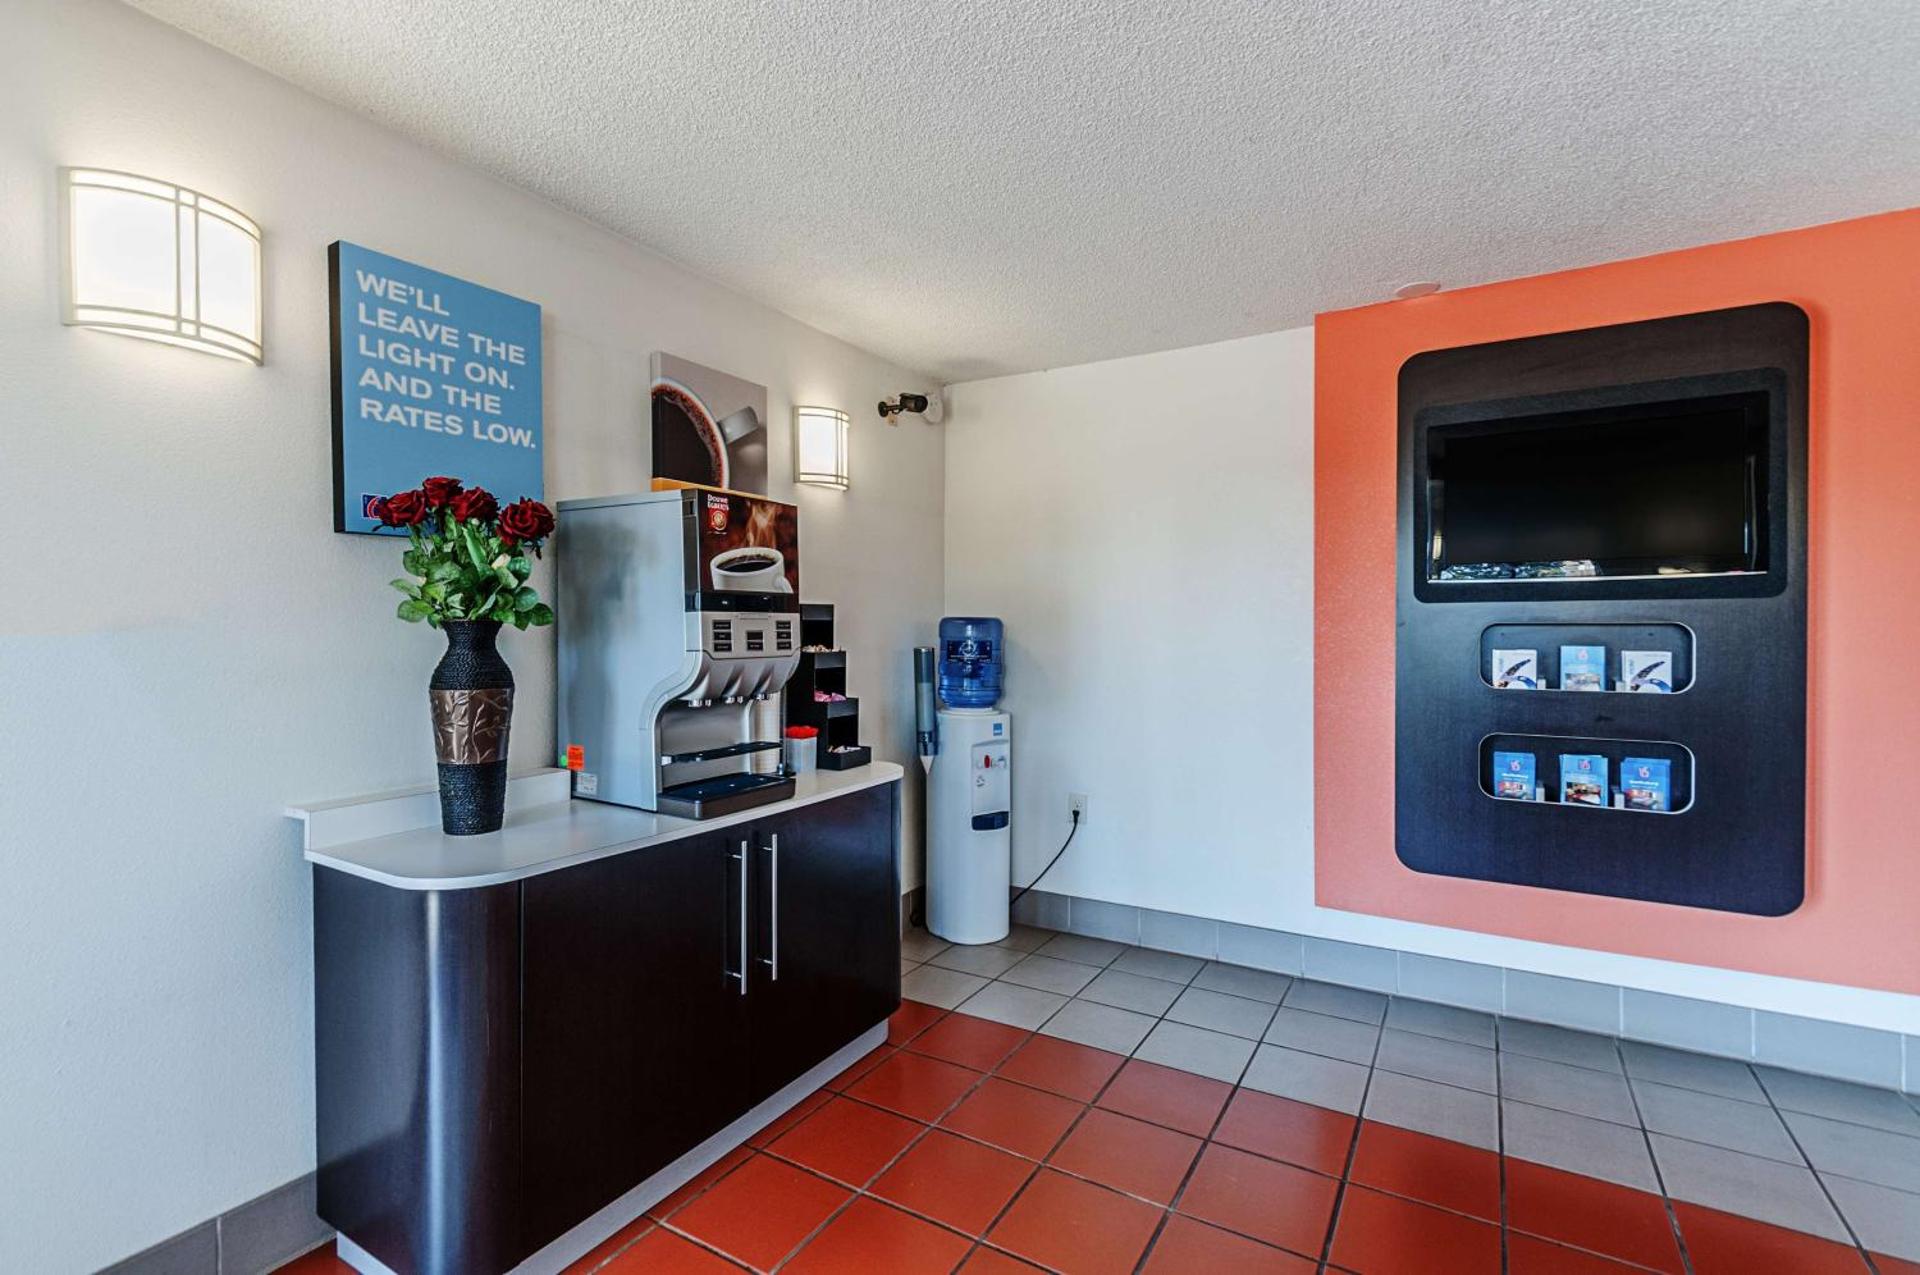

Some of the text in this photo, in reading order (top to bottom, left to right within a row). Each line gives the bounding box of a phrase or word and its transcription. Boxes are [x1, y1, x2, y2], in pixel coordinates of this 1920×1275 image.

[356, 269, 450, 316] WE'LL
[358, 302, 526, 365] LEAVE THE
[359, 334, 515, 390] LIGHT ON.
[358, 367, 501, 415] AND THE
[360, 398, 536, 448] RATES LOW.
